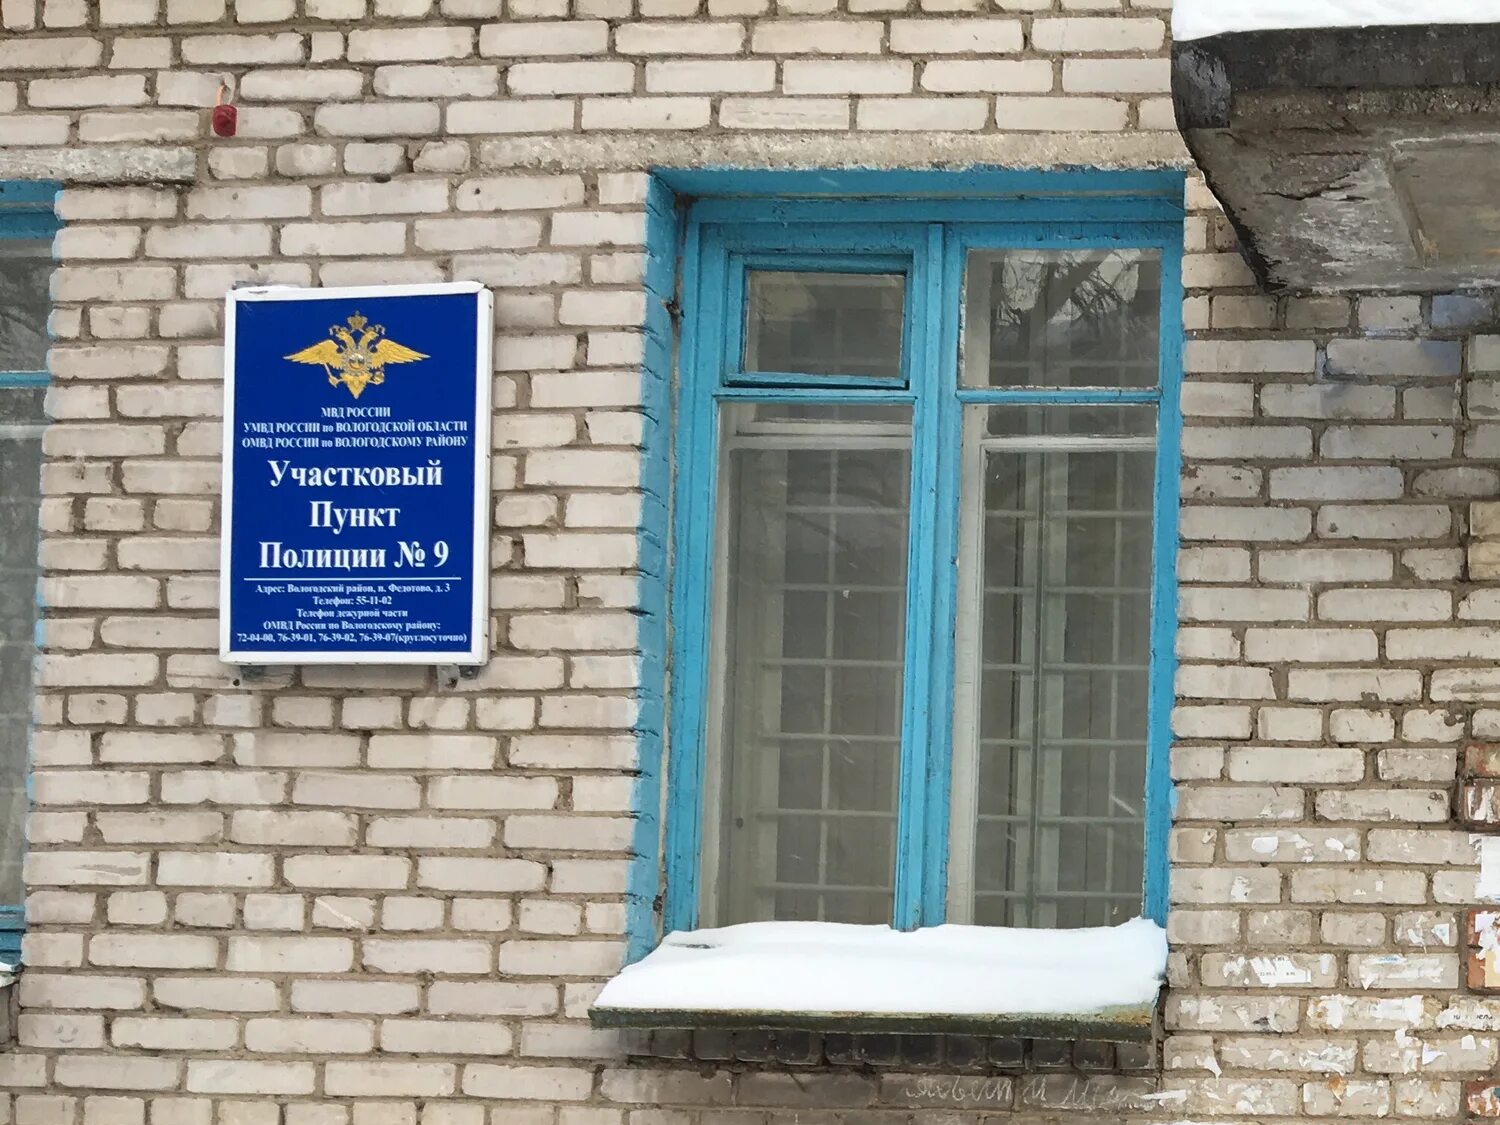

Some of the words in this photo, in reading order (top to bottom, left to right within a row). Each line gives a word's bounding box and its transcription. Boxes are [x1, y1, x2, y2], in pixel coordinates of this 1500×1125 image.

[321, 407, 346, 418] МВД
[347, 407, 391, 417] РОССИИ
[244, 422, 274, 434] УМВД
[275, 422, 320, 433] РОССИИ
[323, 424, 334, 433] по
[336, 419, 415, 433] ВОЛОГОДСКОЙ
[417, 421, 468, 431] ОБЛАСТИ
[242, 437, 273, 449] ОМВД
[275, 437, 319, 448] РОССИИ
[321, 440, 333, 448] по
[334, 437, 423, 448] ВОЛОГОДСКОМУ
[425, 434, 468, 447] РАЙОНУ
[268, 459, 443, 487] Участковый
[309, 500, 401, 534] Пункт
[258, 541, 387, 571] Полиции
[394, 540, 426, 568] №
[434, 540, 449, 568] 9
[255, 585, 285, 595] Адрес:
[287, 584, 344, 594] Вологодский
[346, 584, 376, 595] район,
[389, 584, 433, 594] Федотово,
[445, 584, 450, 592] 3
[312, 596, 354, 607] Телефон:
[355, 596, 392, 605] 55-11-02
[297, 609, 335, 619] Телефон
[336, 608, 380, 619] дежурной
[382, 609, 408, 617] части
[263, 621, 294, 631] ОМВД
[296, 621, 327, 630] России
[341, 621, 405, 631] Вологодскому
[406, 621, 440, 631] району:
